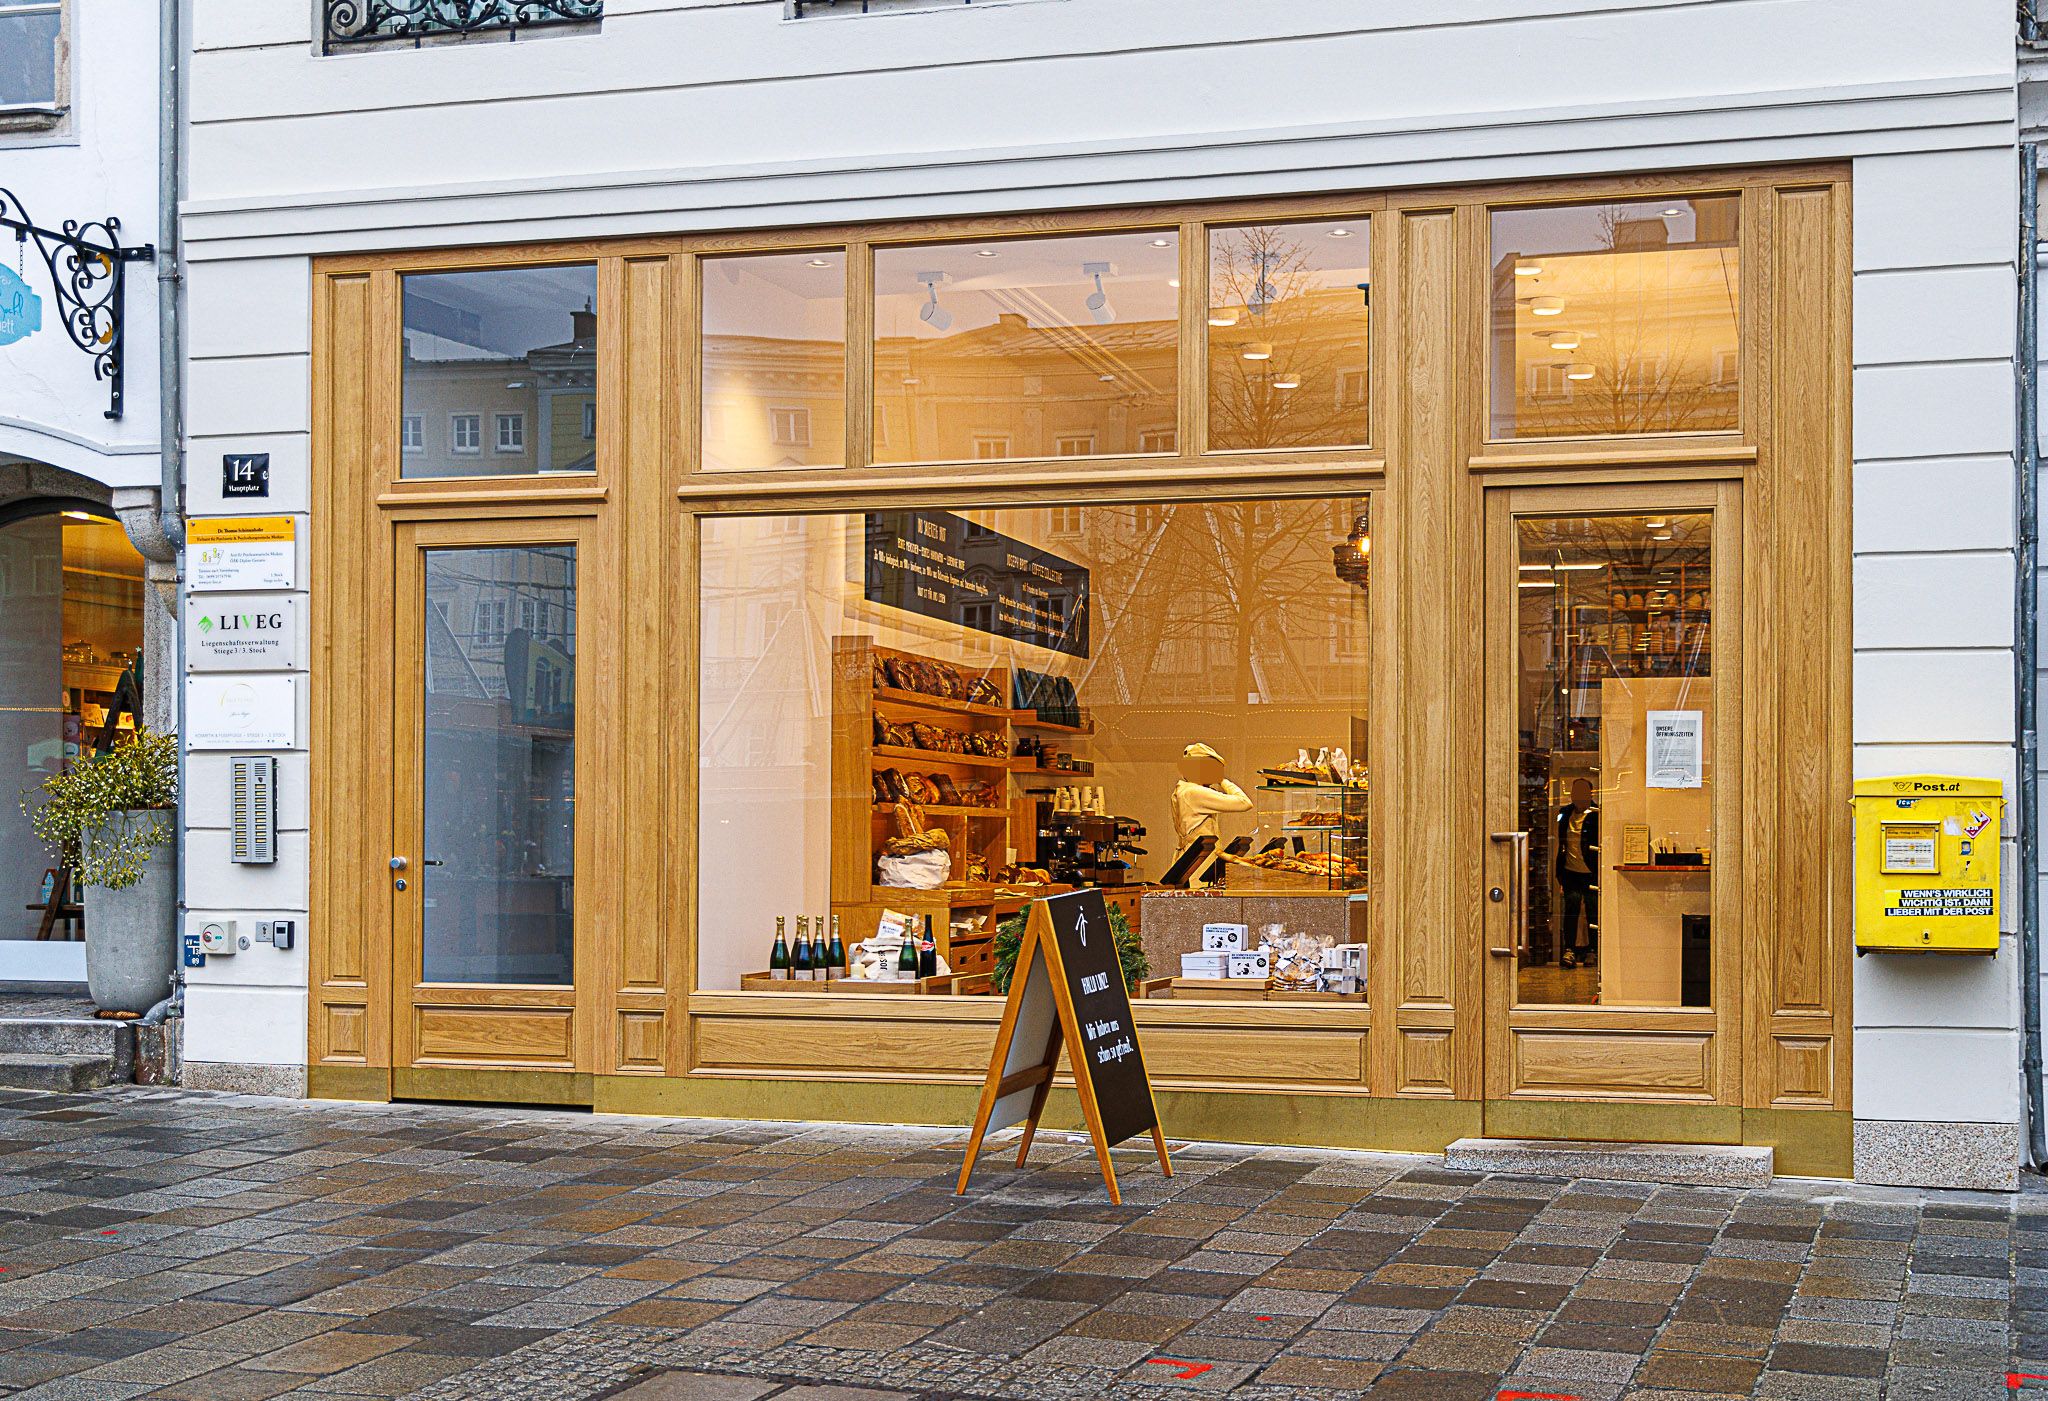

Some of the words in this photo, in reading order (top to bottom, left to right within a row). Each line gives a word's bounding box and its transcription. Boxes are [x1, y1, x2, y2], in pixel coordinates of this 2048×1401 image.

[233, 459, 255, 481] 14
[228, 484, 260, 493] Hauptplatz
[220, 613, 282, 630] LIVEG
[201, 639, 279, 647] Liegenschaftsverwaltung
[1914, 782, 1961, 792] Post.at
[1903, 889, 1941, 898] WENN'S
[1943, 889, 1990, 897] WIRKLICH
[1902, 898, 1942, 907] WICHTIG
[1944, 898, 1961, 907] IST,
[1963, 898, 1990, 906] DANN
[1888, 908, 1921, 916] LIEBER
[1923, 908, 1941, 916] MIT
[1964, 907, 1991, 915] POST
